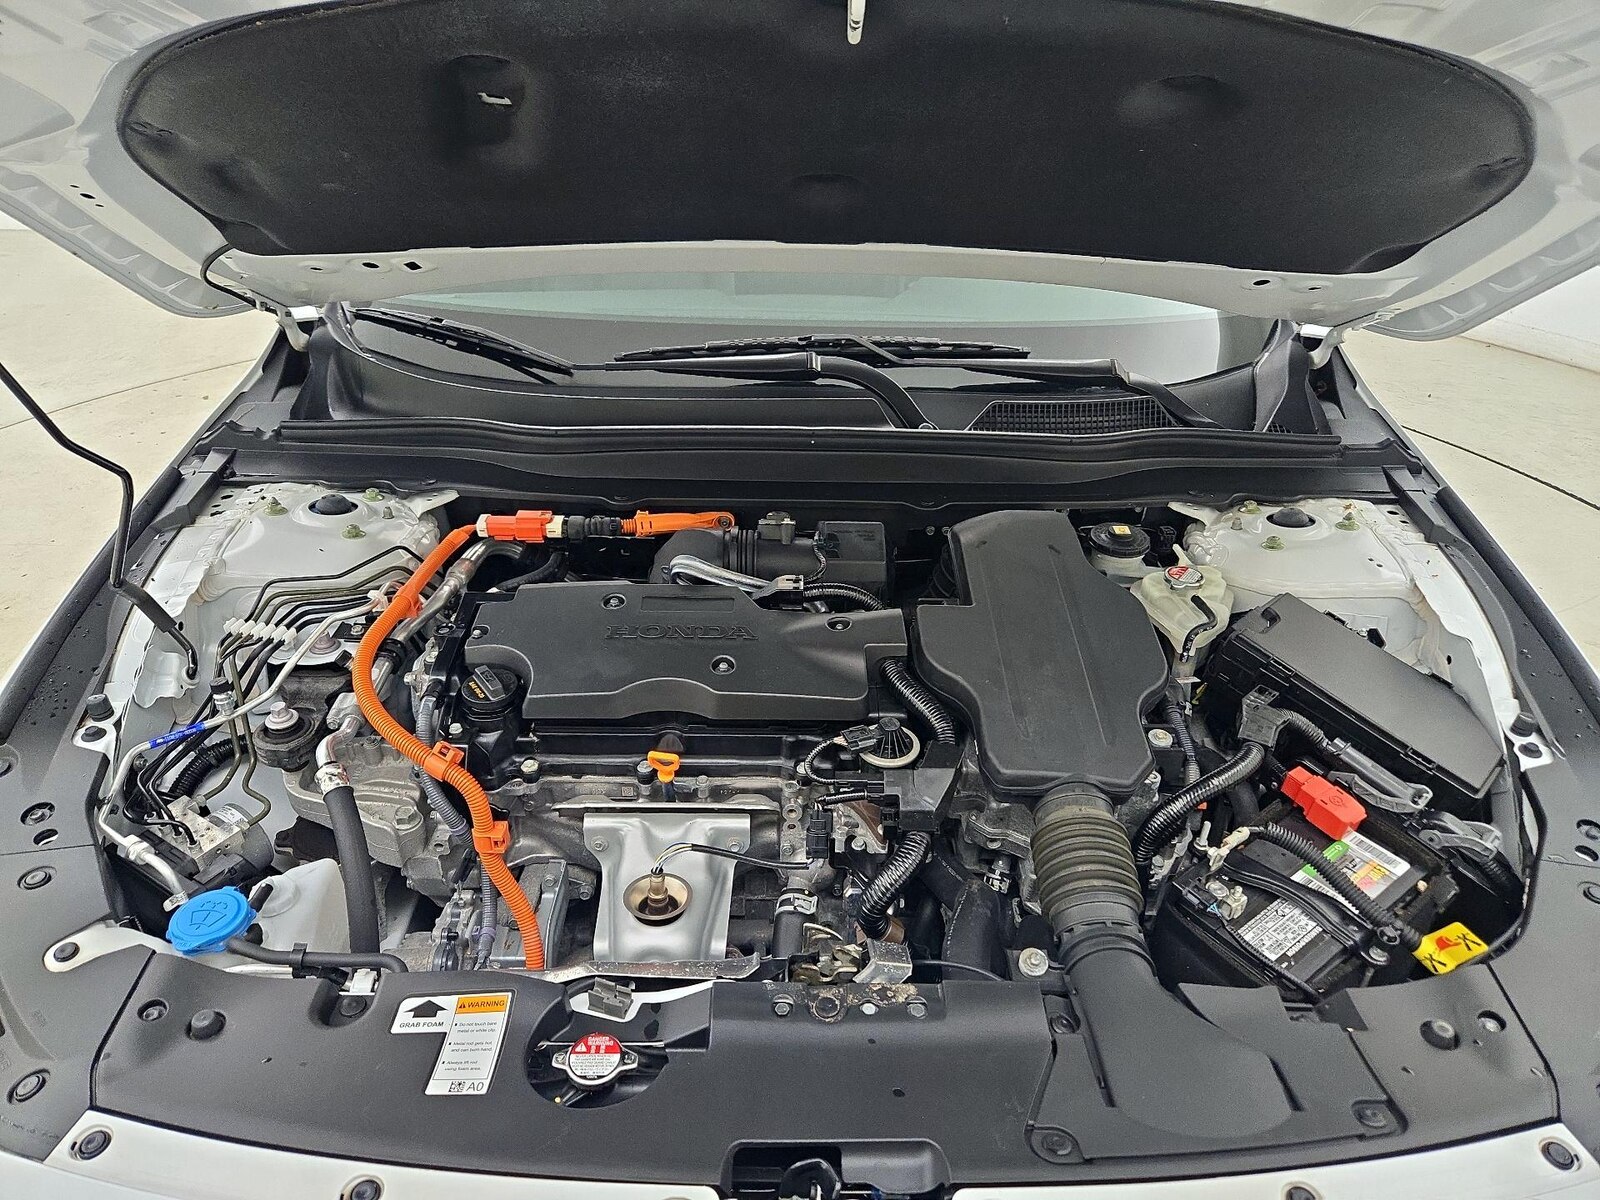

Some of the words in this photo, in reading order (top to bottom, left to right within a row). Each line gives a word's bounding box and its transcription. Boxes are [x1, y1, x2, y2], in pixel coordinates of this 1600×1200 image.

[605, 624, 759, 640] HONDA
[467, 1000, 505, 1009] WARNING
[466, 1081, 485, 1092] A0
